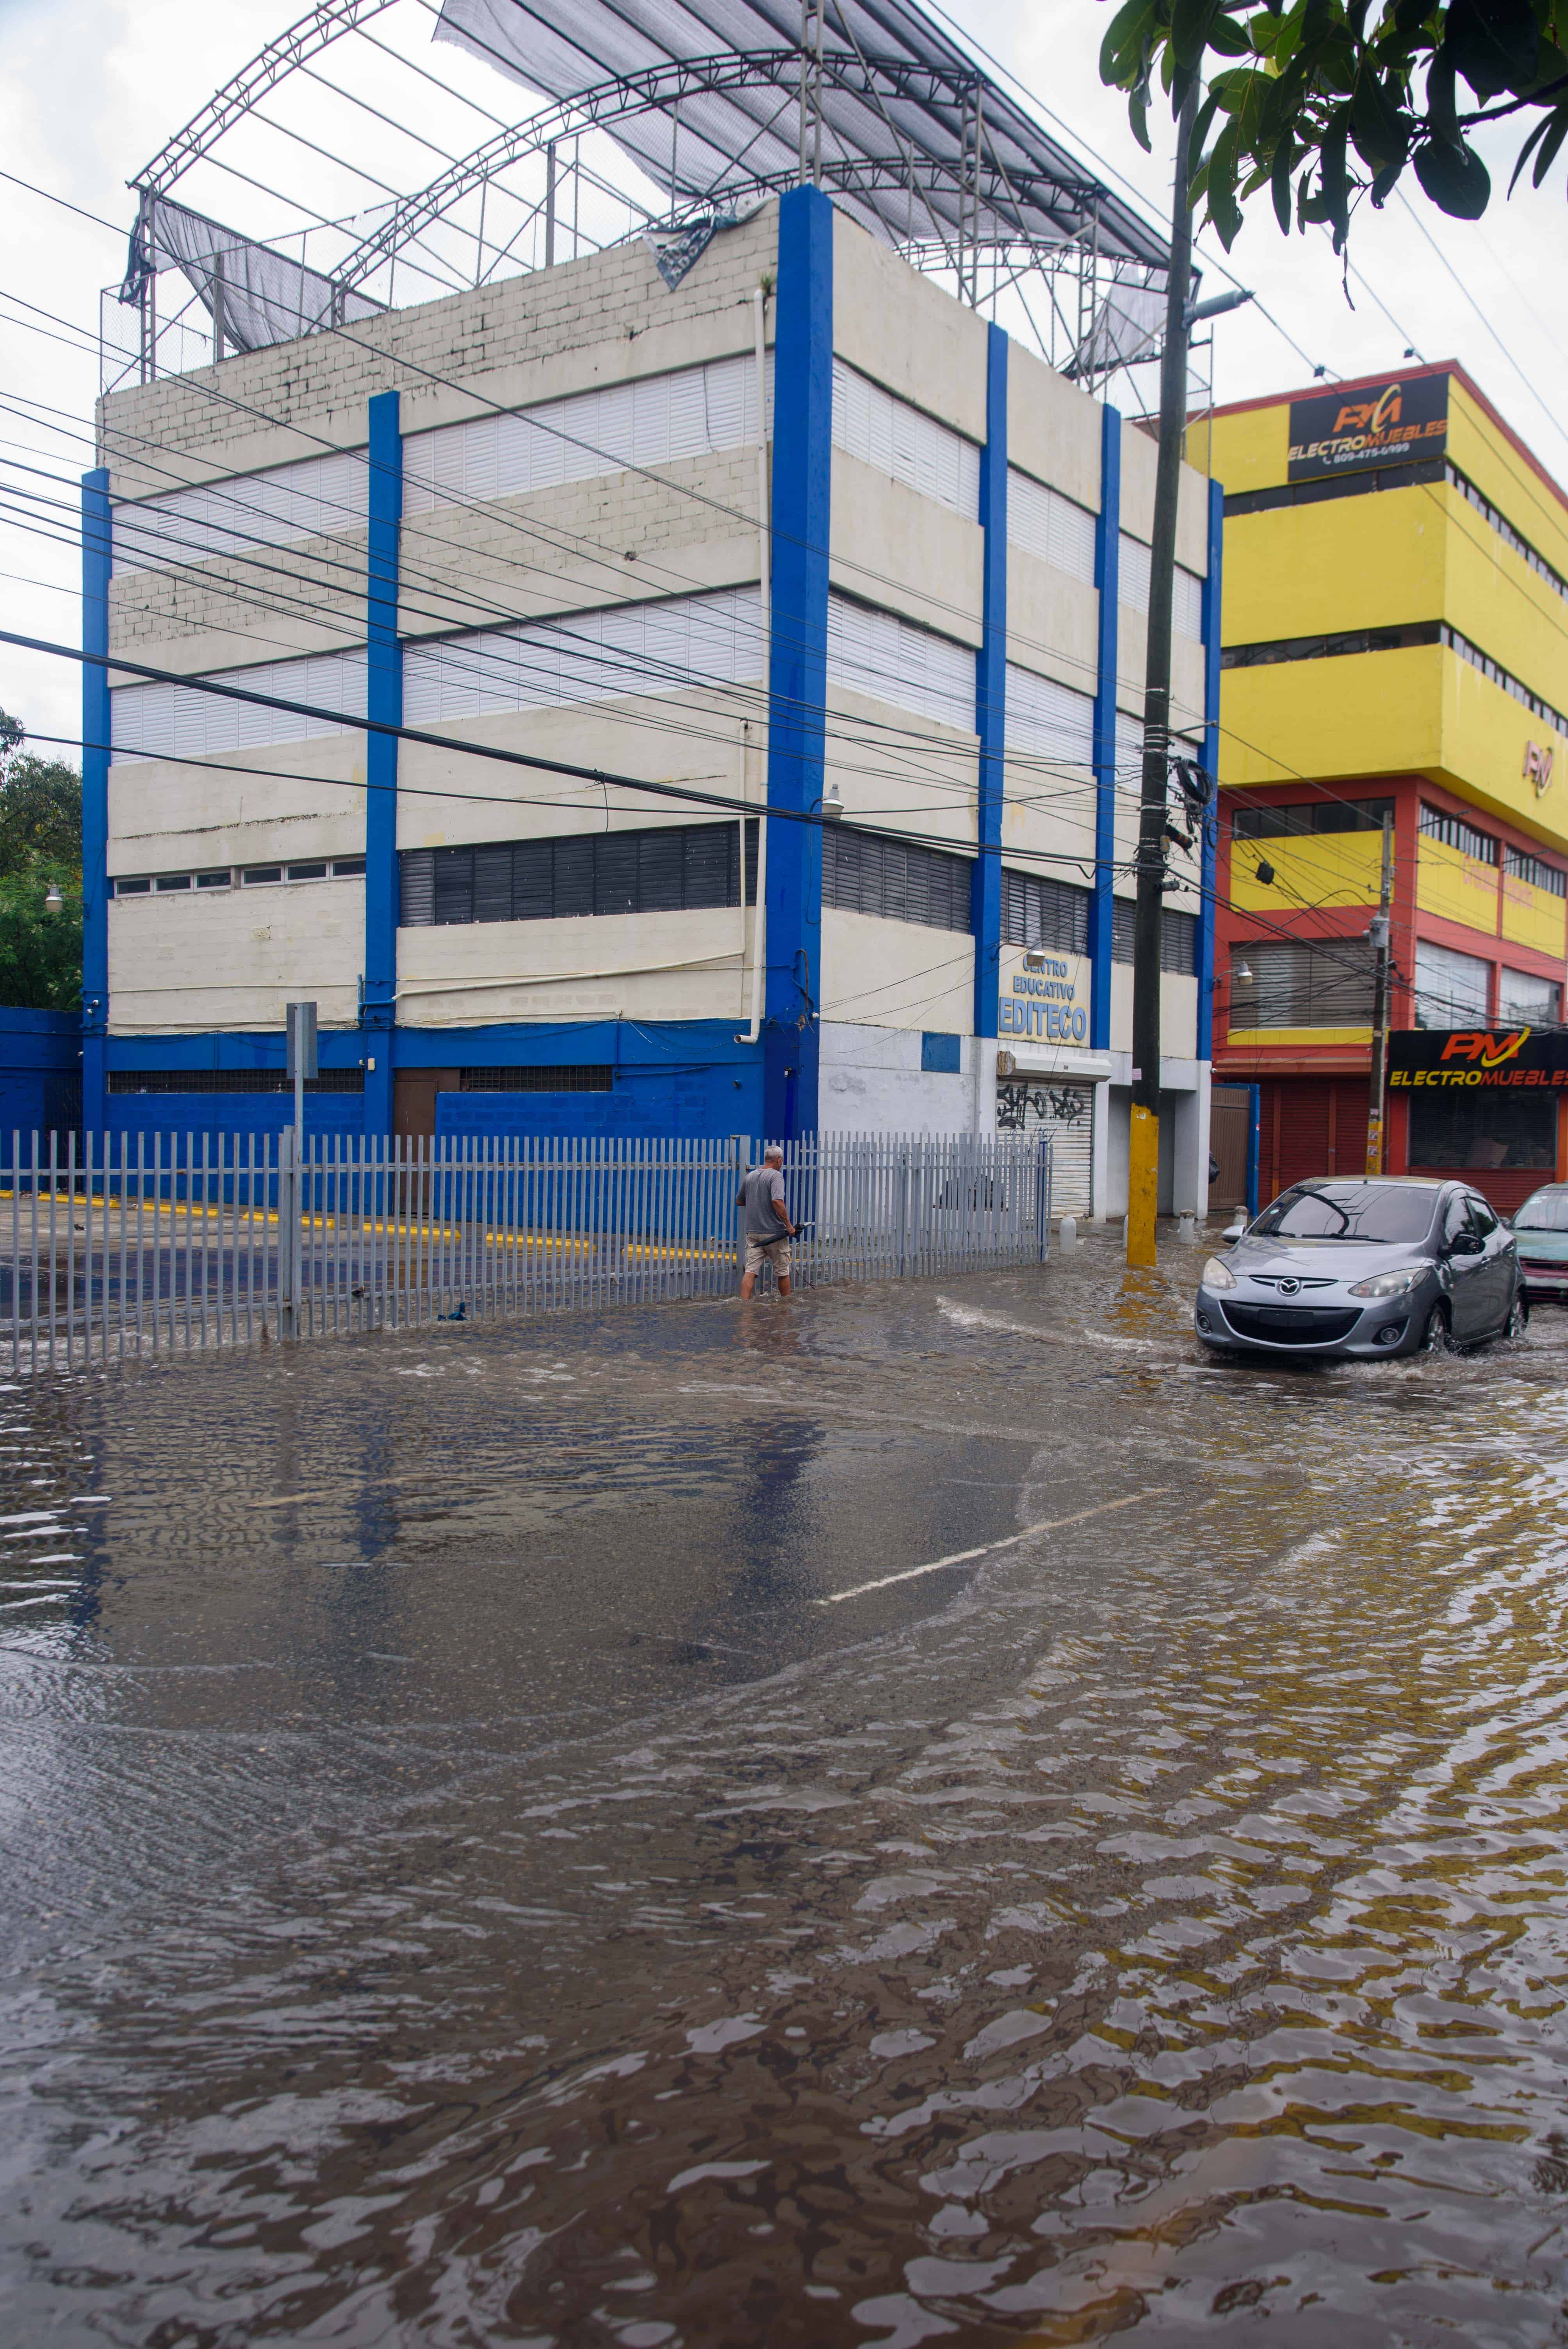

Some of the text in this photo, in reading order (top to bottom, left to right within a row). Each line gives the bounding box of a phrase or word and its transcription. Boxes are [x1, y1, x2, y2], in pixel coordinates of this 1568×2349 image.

[1288, 419, 1448, 462] ELECTROMUEBLES
[1013, 975, 1075, 1001] EDUCATIVO
[999, 996, 1087, 1041] EDITECO
